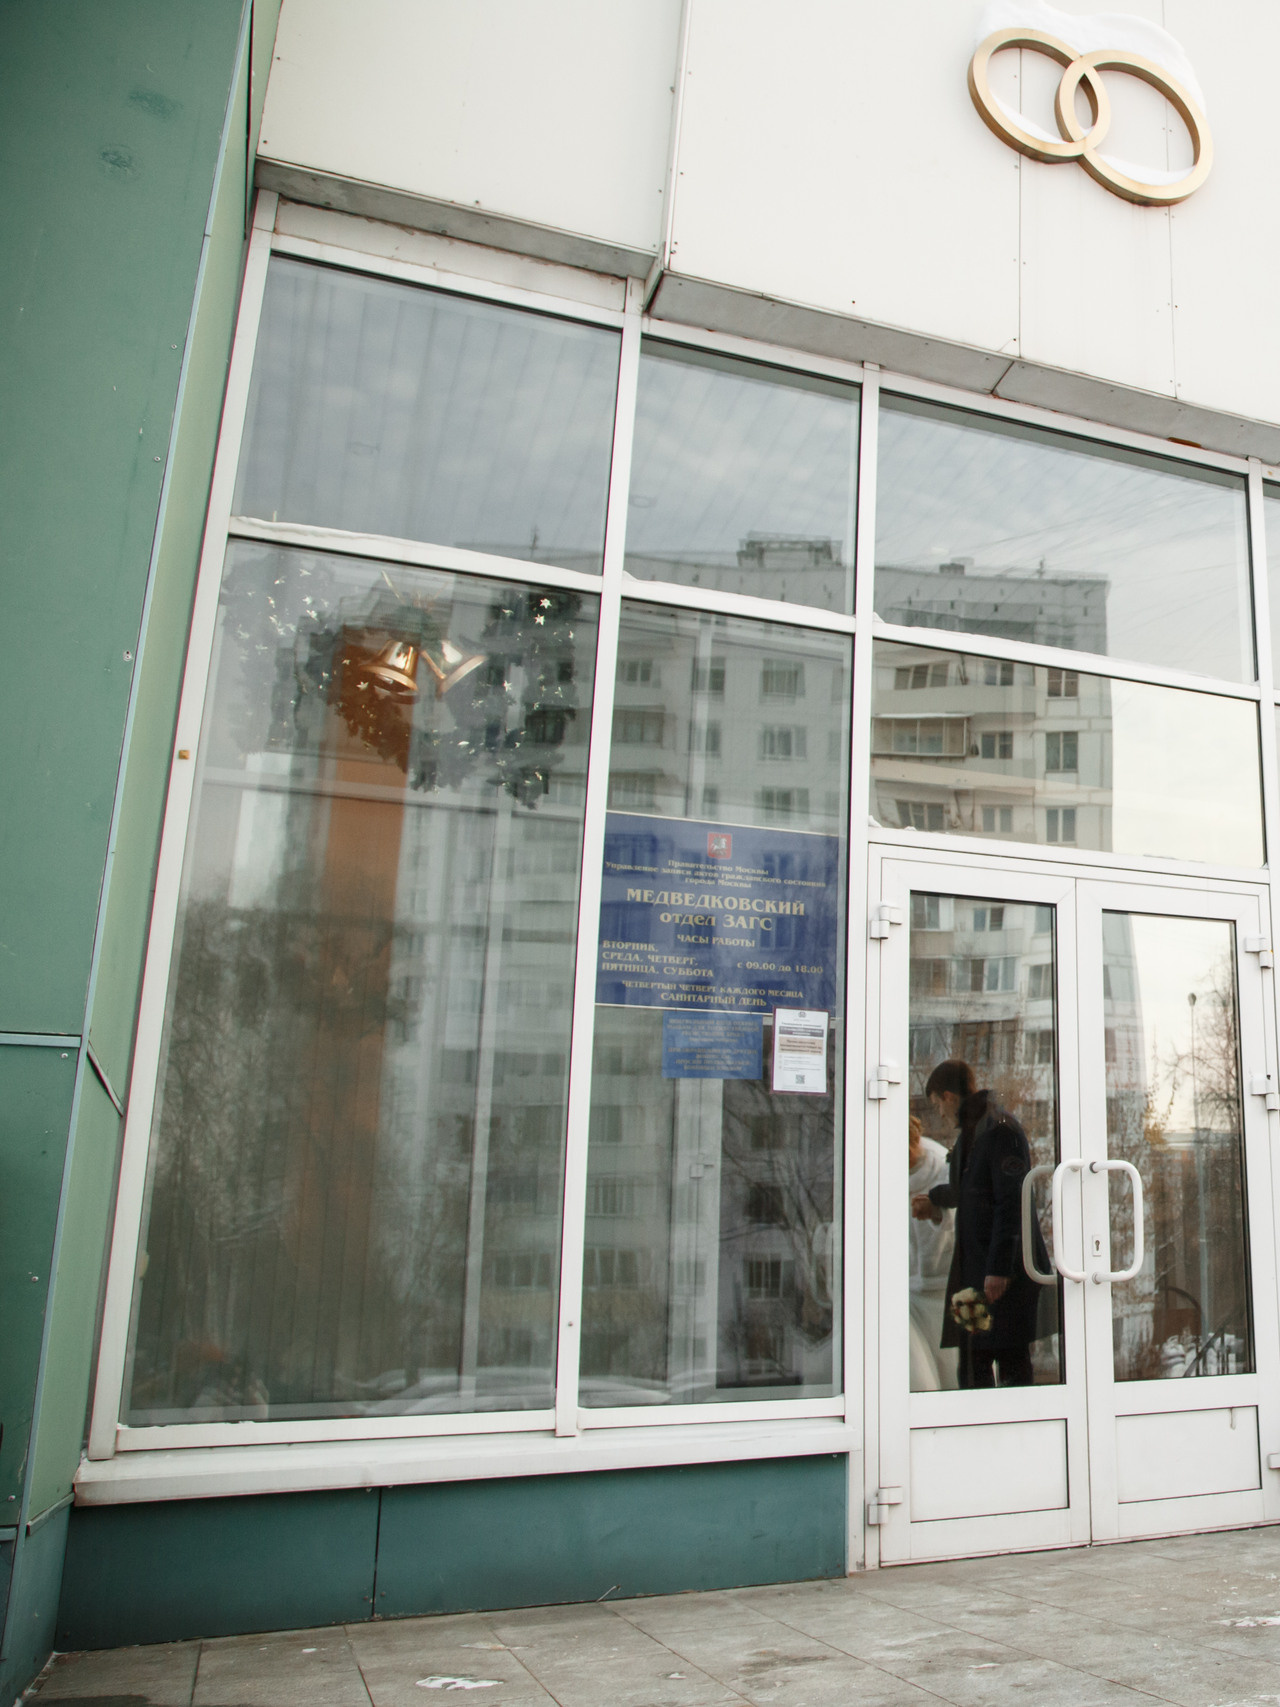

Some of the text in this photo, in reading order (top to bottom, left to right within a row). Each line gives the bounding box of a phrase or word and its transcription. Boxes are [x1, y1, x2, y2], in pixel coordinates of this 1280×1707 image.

[626, 888, 805, 916] МЕДВЕДКОВСКИЙ
[659, 912, 773, 931] отдел ЗАГС
[676, 934, 755, 948] ЧАСЫ РАБОТЫ
[663, 966, 714, 977] СУББОТА
[746, 961, 776, 971] 09.00
[795, 965, 824, 973] 18.00
[738, 996, 767, 1006] ДЕНЬ
